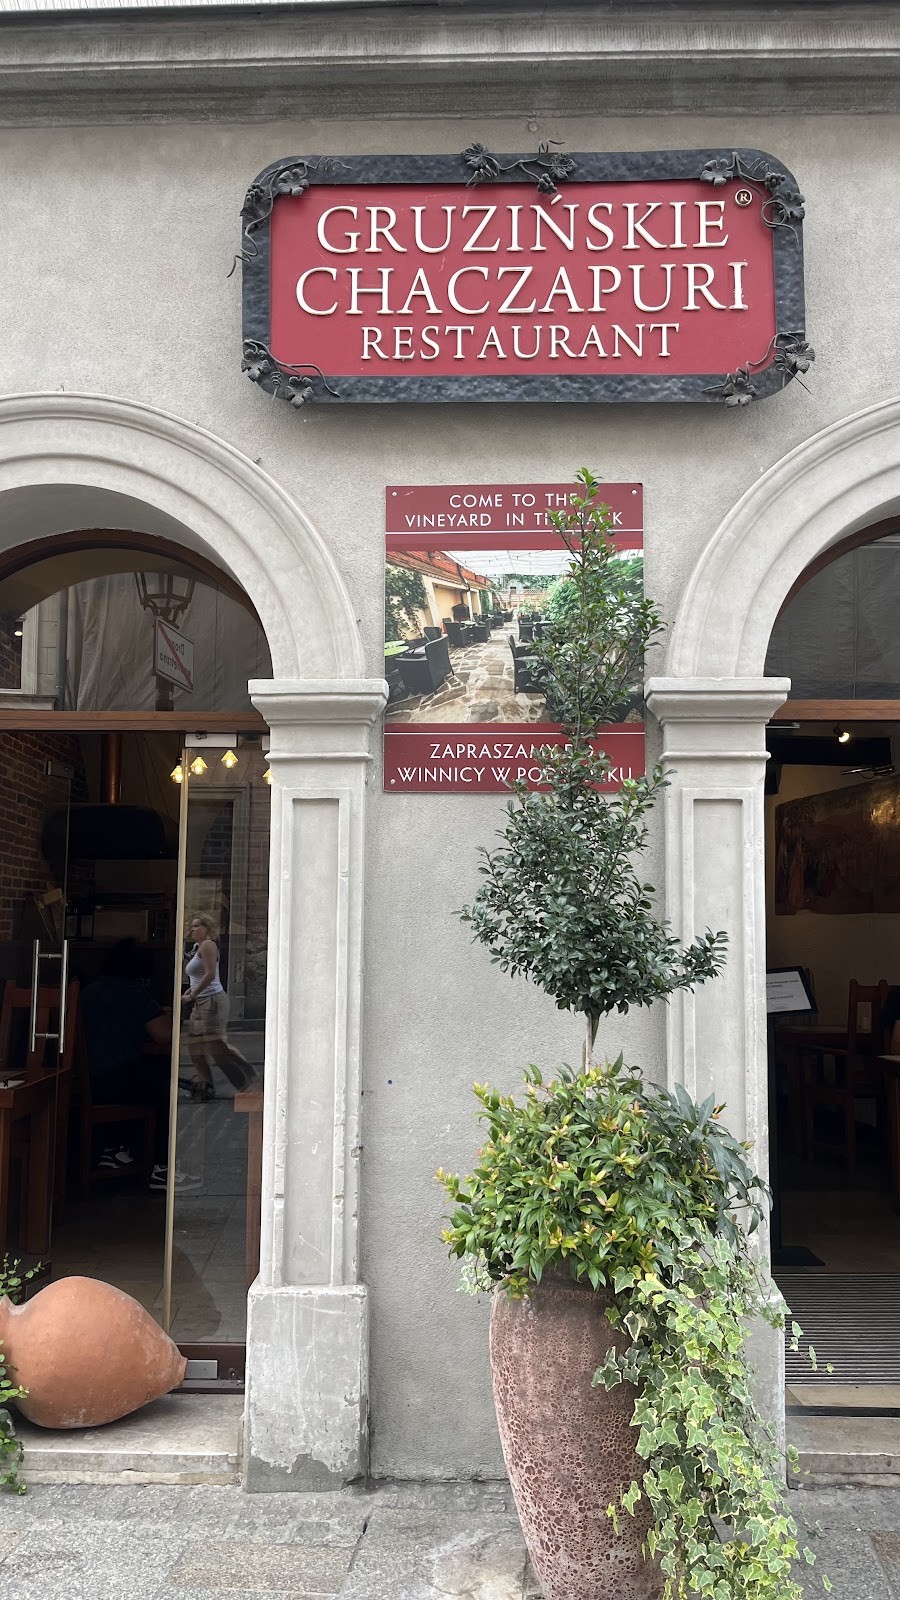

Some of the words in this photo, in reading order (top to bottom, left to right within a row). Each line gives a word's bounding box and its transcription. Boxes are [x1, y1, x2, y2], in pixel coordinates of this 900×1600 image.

[316, 194, 729, 254] GRUZIŃSKIE
[295, 261, 749, 316] CHACZAPURI
[361, 322, 680, 361] RESTAURANT
[449, 493, 503, 508] COME
[512, 493, 536, 507] TO
[405, 513, 492, 528] VINEYARD
[506, 513, 524, 526] IN
[430, 743, 558, 759] ZAPRASZAMY
[398, 767, 486, 783] WINNICY
[491, 767, 514, 783] W
